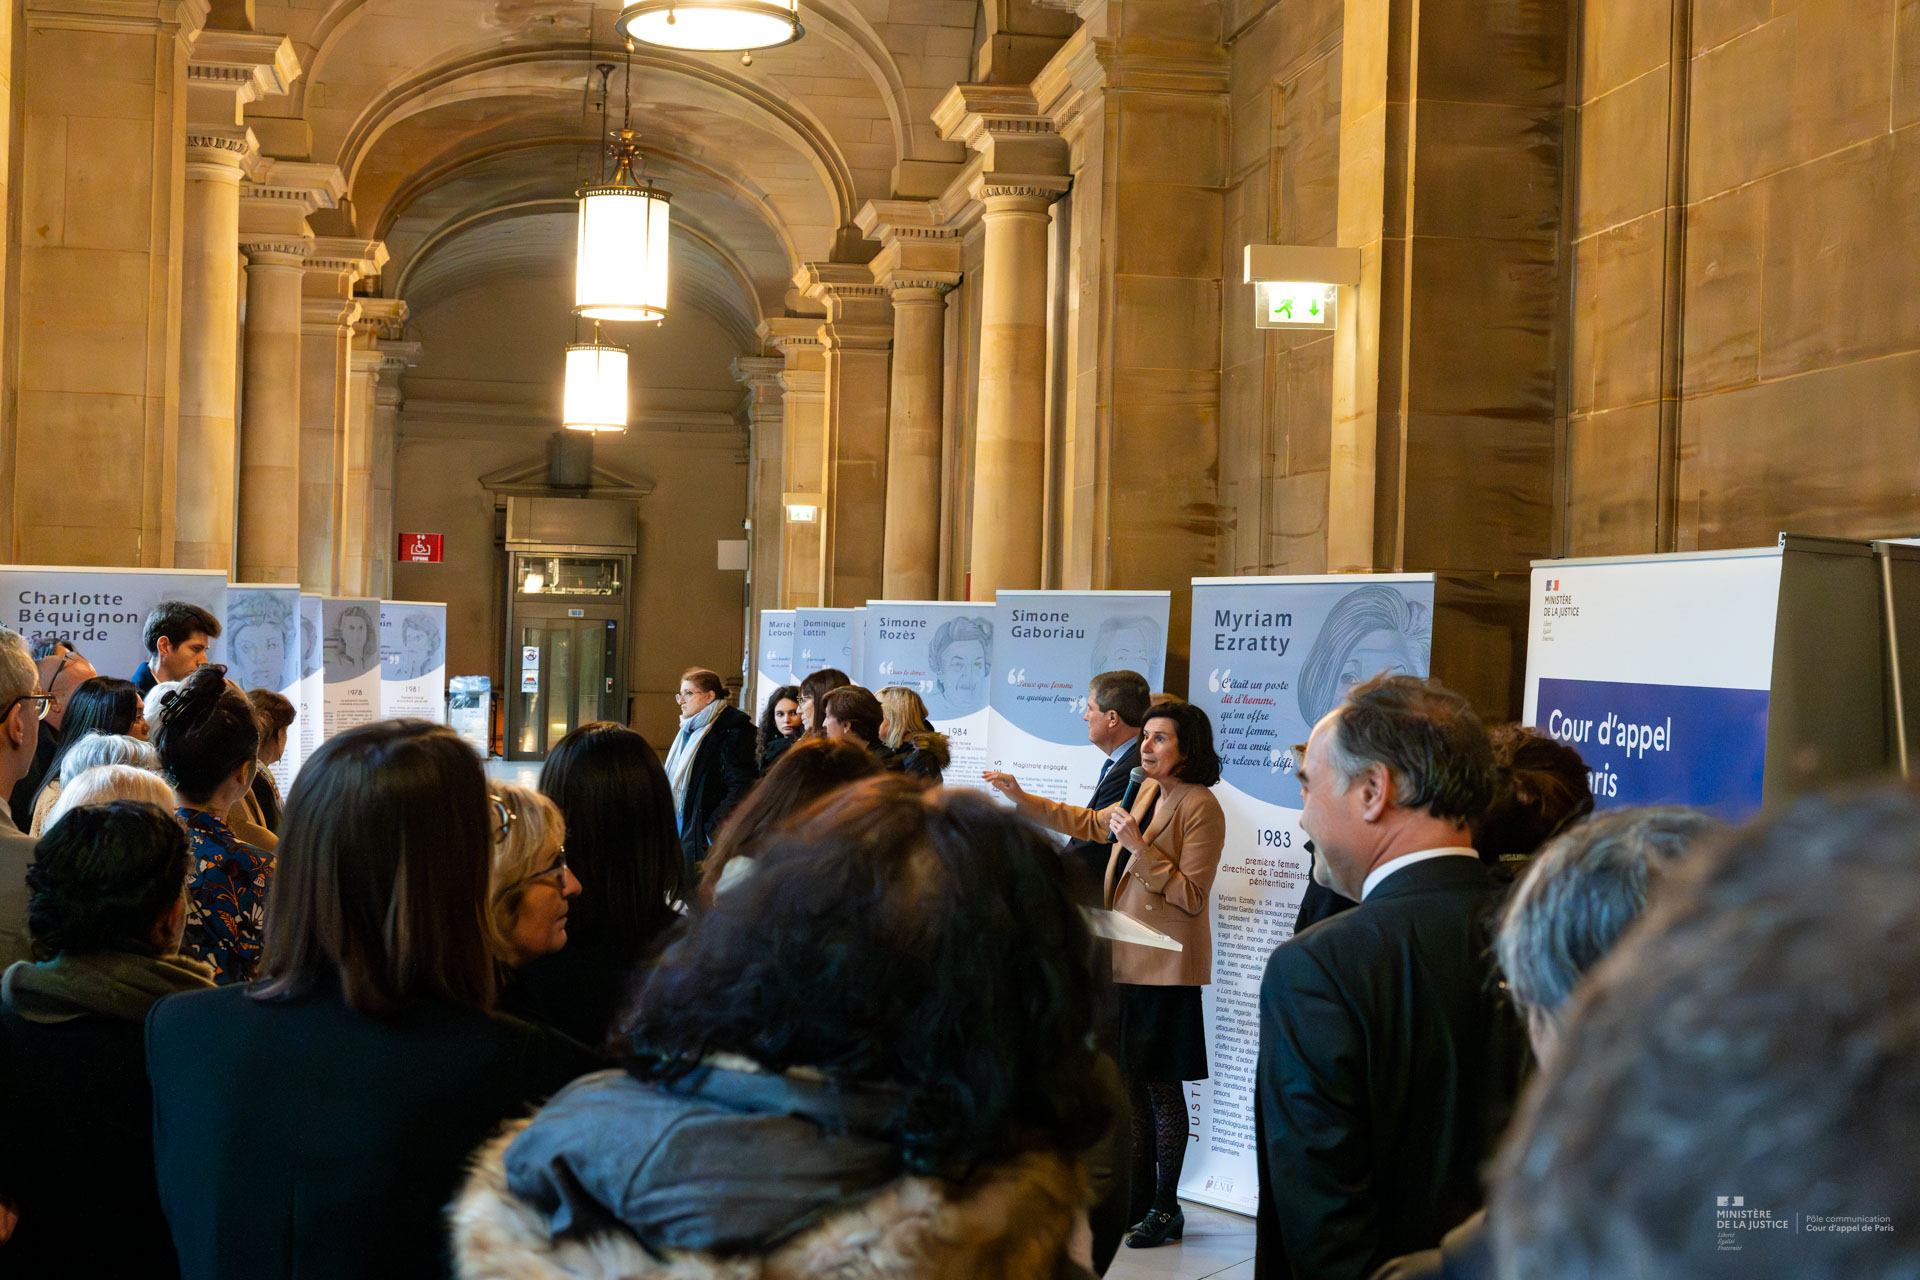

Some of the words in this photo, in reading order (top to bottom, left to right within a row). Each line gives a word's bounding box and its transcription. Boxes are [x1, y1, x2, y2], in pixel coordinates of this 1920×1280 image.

[19, 591, 122, 605] Charlotte
[1545, 594, 1572, 605] MINISTÈRE
[19, 609, 138, 626] Béquignon
[1012, 610, 1070, 622] Simone
[1544, 608, 1550, 616] DE
[1552, 608, 1558, 616] LA
[1559, 607, 1579, 618] JUSTICE
[804, 620, 846, 629] Dominique
[880, 617, 926, 628] Simone
[1215, 610, 1292, 632] Myriam
[880, 630, 916, 640] Rozès
[1011, 625, 1084, 638] Gaboriau
[1215, 634, 1290, 656] Ezratty
[1051, 681, 1072, 690] femme
[1222, 678, 1248, 689] C'était
[1264, 681, 1288, 692] poste
[1054, 694, 1076, 703] femme
[1221, 693, 1232, 704] dit
[1235, 694, 1277, 706] d'homme,
[1221, 709, 1244, 721] qu'on
[1247, 710, 1269, 723] offre
[948, 728, 968, 736] 1984
[1220, 724, 1226, 734] à
[1246, 725, 1278, 738] femme,
[1549, 708, 1592, 742] Cour
[1598, 712, 1671, 759] d'appel
[1220, 740, 1235, 752] j'ai
[1250, 742, 1272, 751] envie
[1232, 756, 1260, 766] relever
[1263, 757, 1271, 767] le
[1274, 756, 1293, 771] défi.
[1586, 762, 1618, 798] aris
[1258, 829, 1291, 848] 1983
[1245, 858, 1275, 866] première
[1278, 859, 1299, 869] femme
[1222, 864, 1255, 875] directrice
[1258, 868, 1267, 876] de
[1270, 869, 1310, 880] l'administra
[1249, 878, 1295, 889] pénitentiaire
[1239, 896, 1256, 906] Ezratty
[1288, 902, 1301, 910] lorsq
[1239, 906, 1254, 914] Garde
[1215, 1052, 1233, 1060] Femme
[1189, 1082, 1200, 1142] JUSTI
